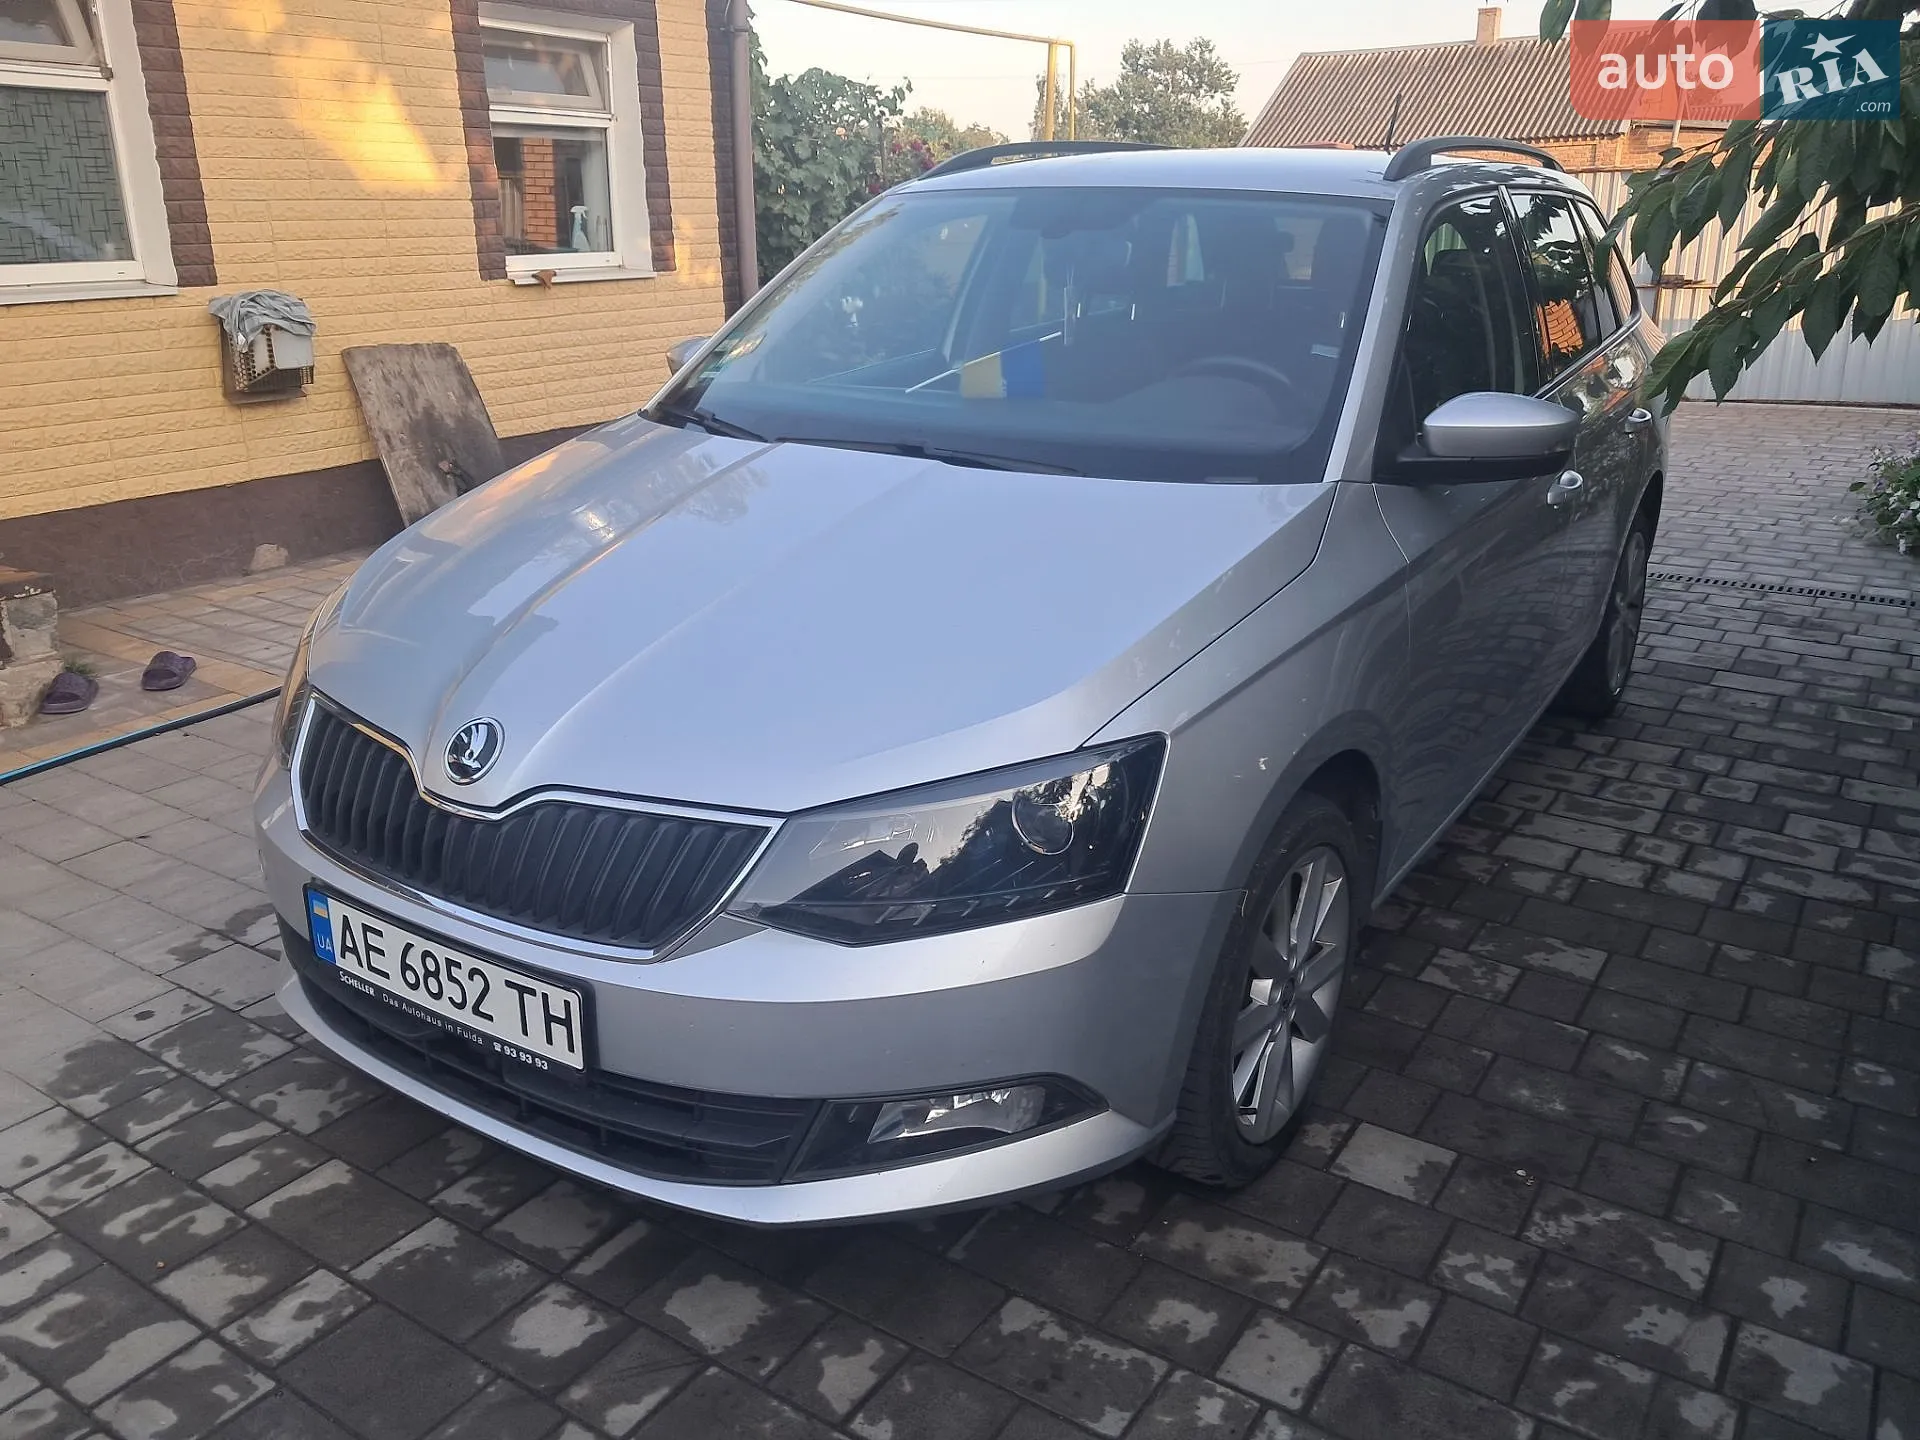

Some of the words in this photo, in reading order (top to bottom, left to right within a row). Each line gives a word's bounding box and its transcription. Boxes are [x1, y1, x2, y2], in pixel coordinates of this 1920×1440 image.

[318, 936, 333, 953] UA
[340, 914, 390, 981] AE
[400, 942, 494, 1023] 6852
[504, 979, 575, 1054] TH
[339, 970, 375, 997] SCHELLER
[382, 992, 399, 1008] Das
[402, 1002, 442, 1027] Autohaus
[445, 1022, 454, 1033] in
[457, 1026, 483, 1045] Fulda
[503, 1045, 517, 1058] 93
[519, 1051, 533, 1064] 93
[535, 1057, 548, 1070] 93
